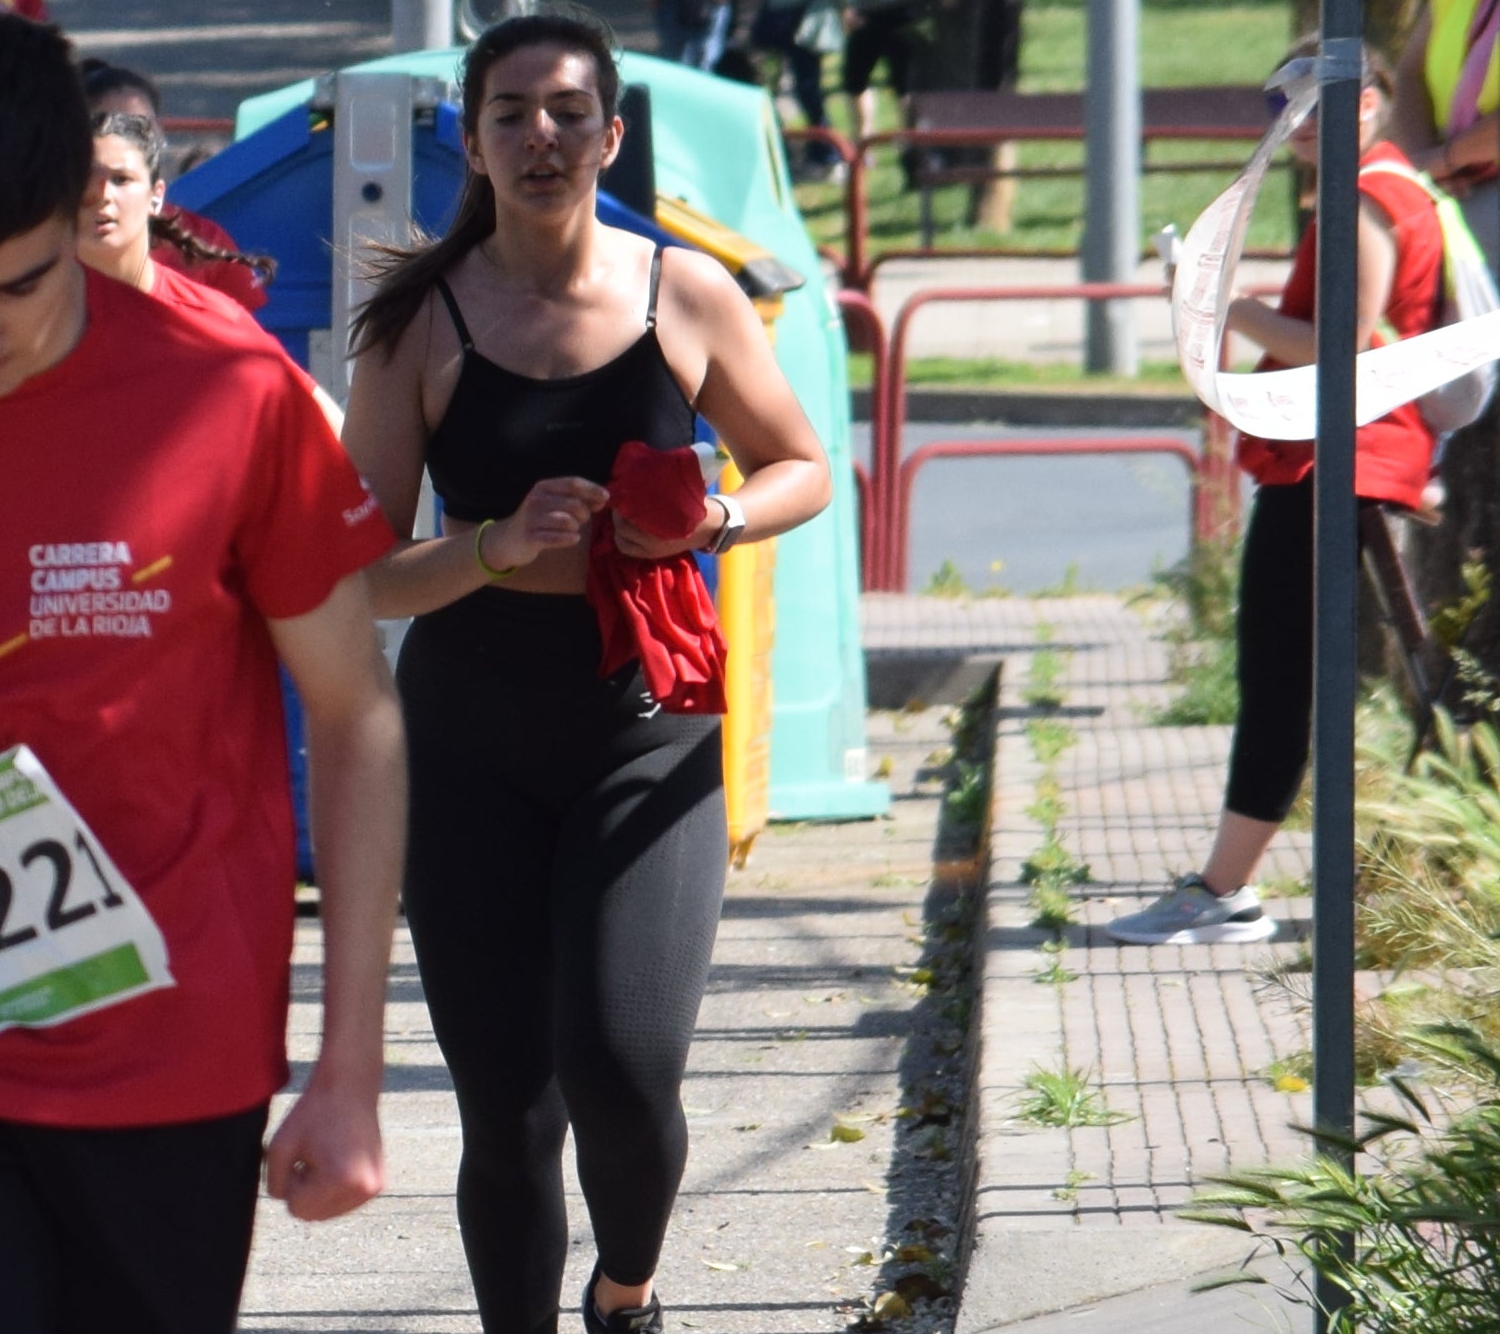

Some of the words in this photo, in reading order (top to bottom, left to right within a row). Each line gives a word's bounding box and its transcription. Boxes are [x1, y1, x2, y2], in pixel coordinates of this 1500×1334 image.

[28, 541, 132, 566] CARRERA
[30, 567, 121, 592] CAMPUS
[30, 589, 171, 616] UNIVERSIDAD
[29, 617, 58, 638] DE
[61, 616, 87, 637] LA
[92, 616, 152, 637] RIOJA
